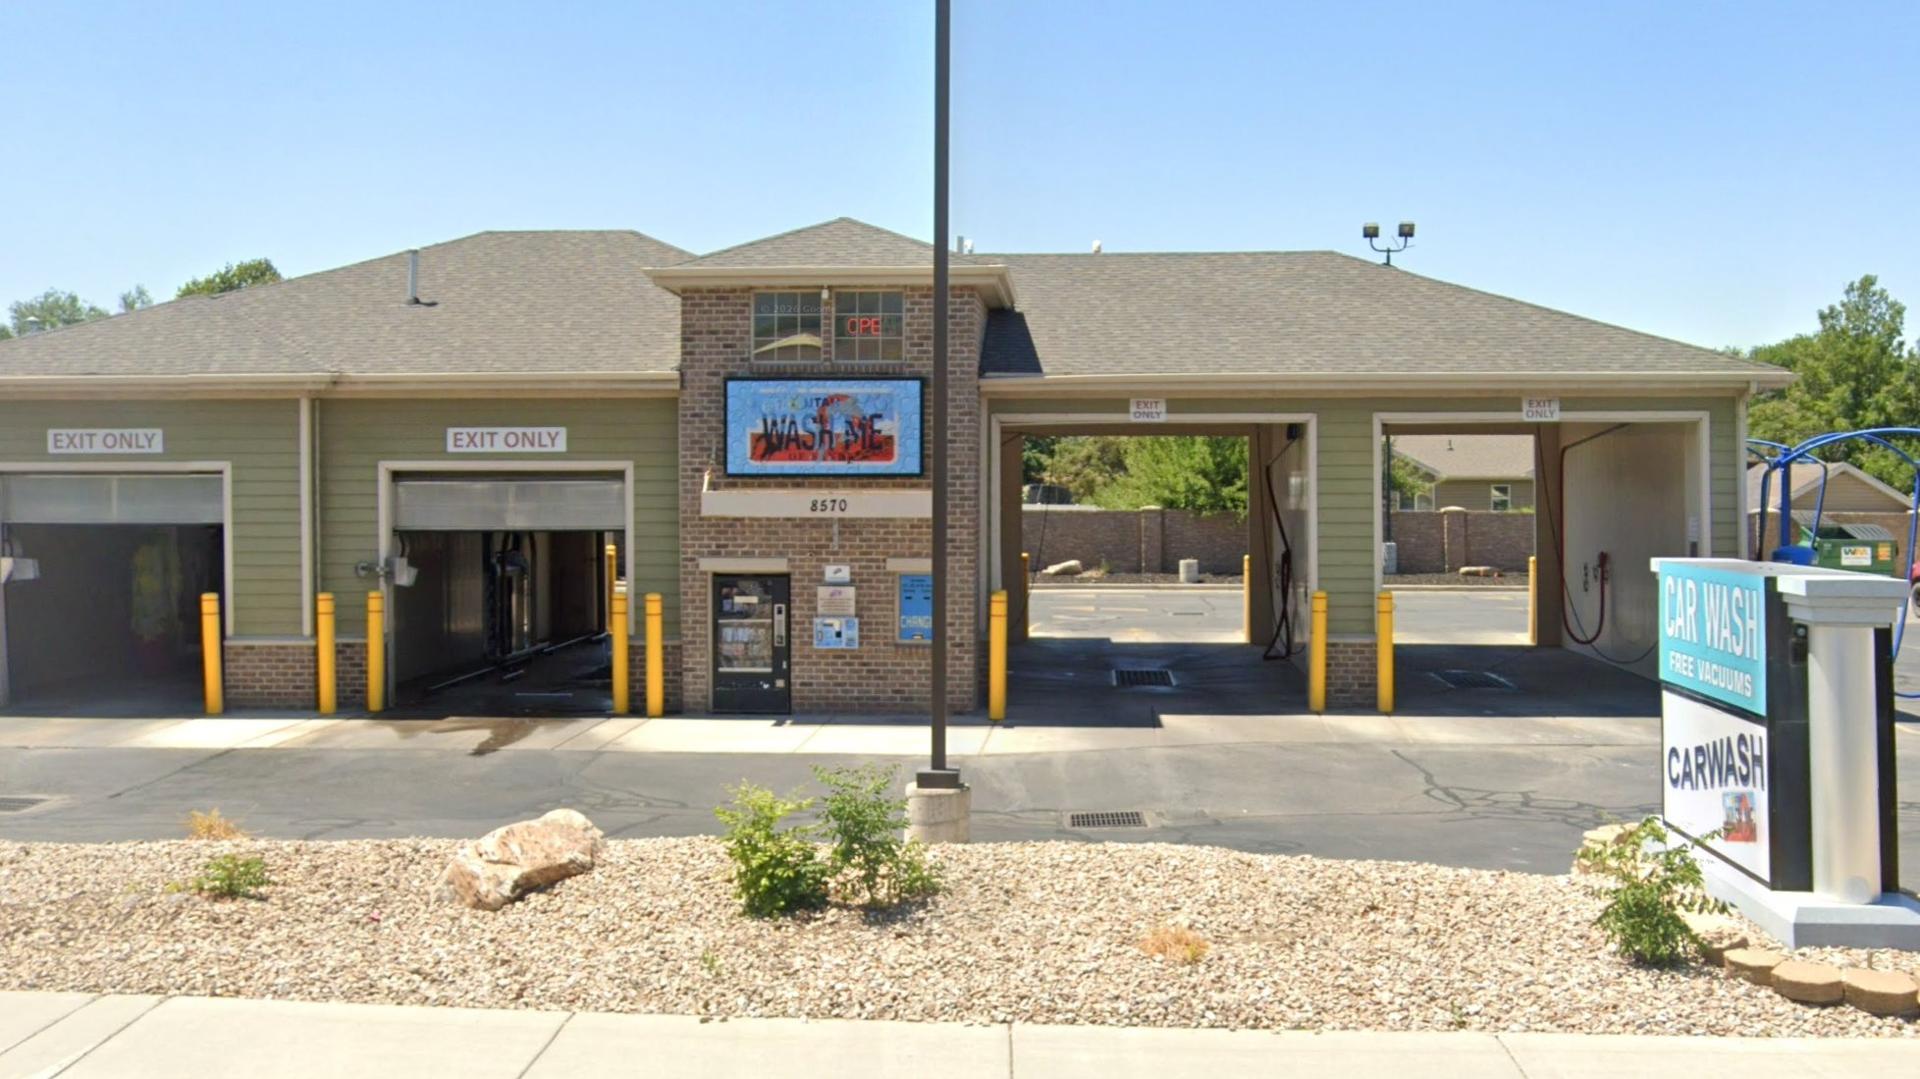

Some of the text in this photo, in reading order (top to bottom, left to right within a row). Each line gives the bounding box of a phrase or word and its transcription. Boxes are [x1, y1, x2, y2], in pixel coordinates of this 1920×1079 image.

[1135, 400, 1160, 410] EXIT
[1527, 399, 1552, 409] EXIT
[1133, 411, 1161, 419] ONLY
[1526, 410, 1555, 419] ONLY
[53, 432, 157, 449] EXIT ONLY
[453, 431, 560, 449] EXIT ONLY
[761, 412, 884, 453] WASH ME
[810, 498, 848, 512] 8570
[1664, 575, 1759, 661] CAR WASH
[1670, 650, 1752, 698] FREE VACUUMS
[1668, 732, 1766, 792] CARWASH
